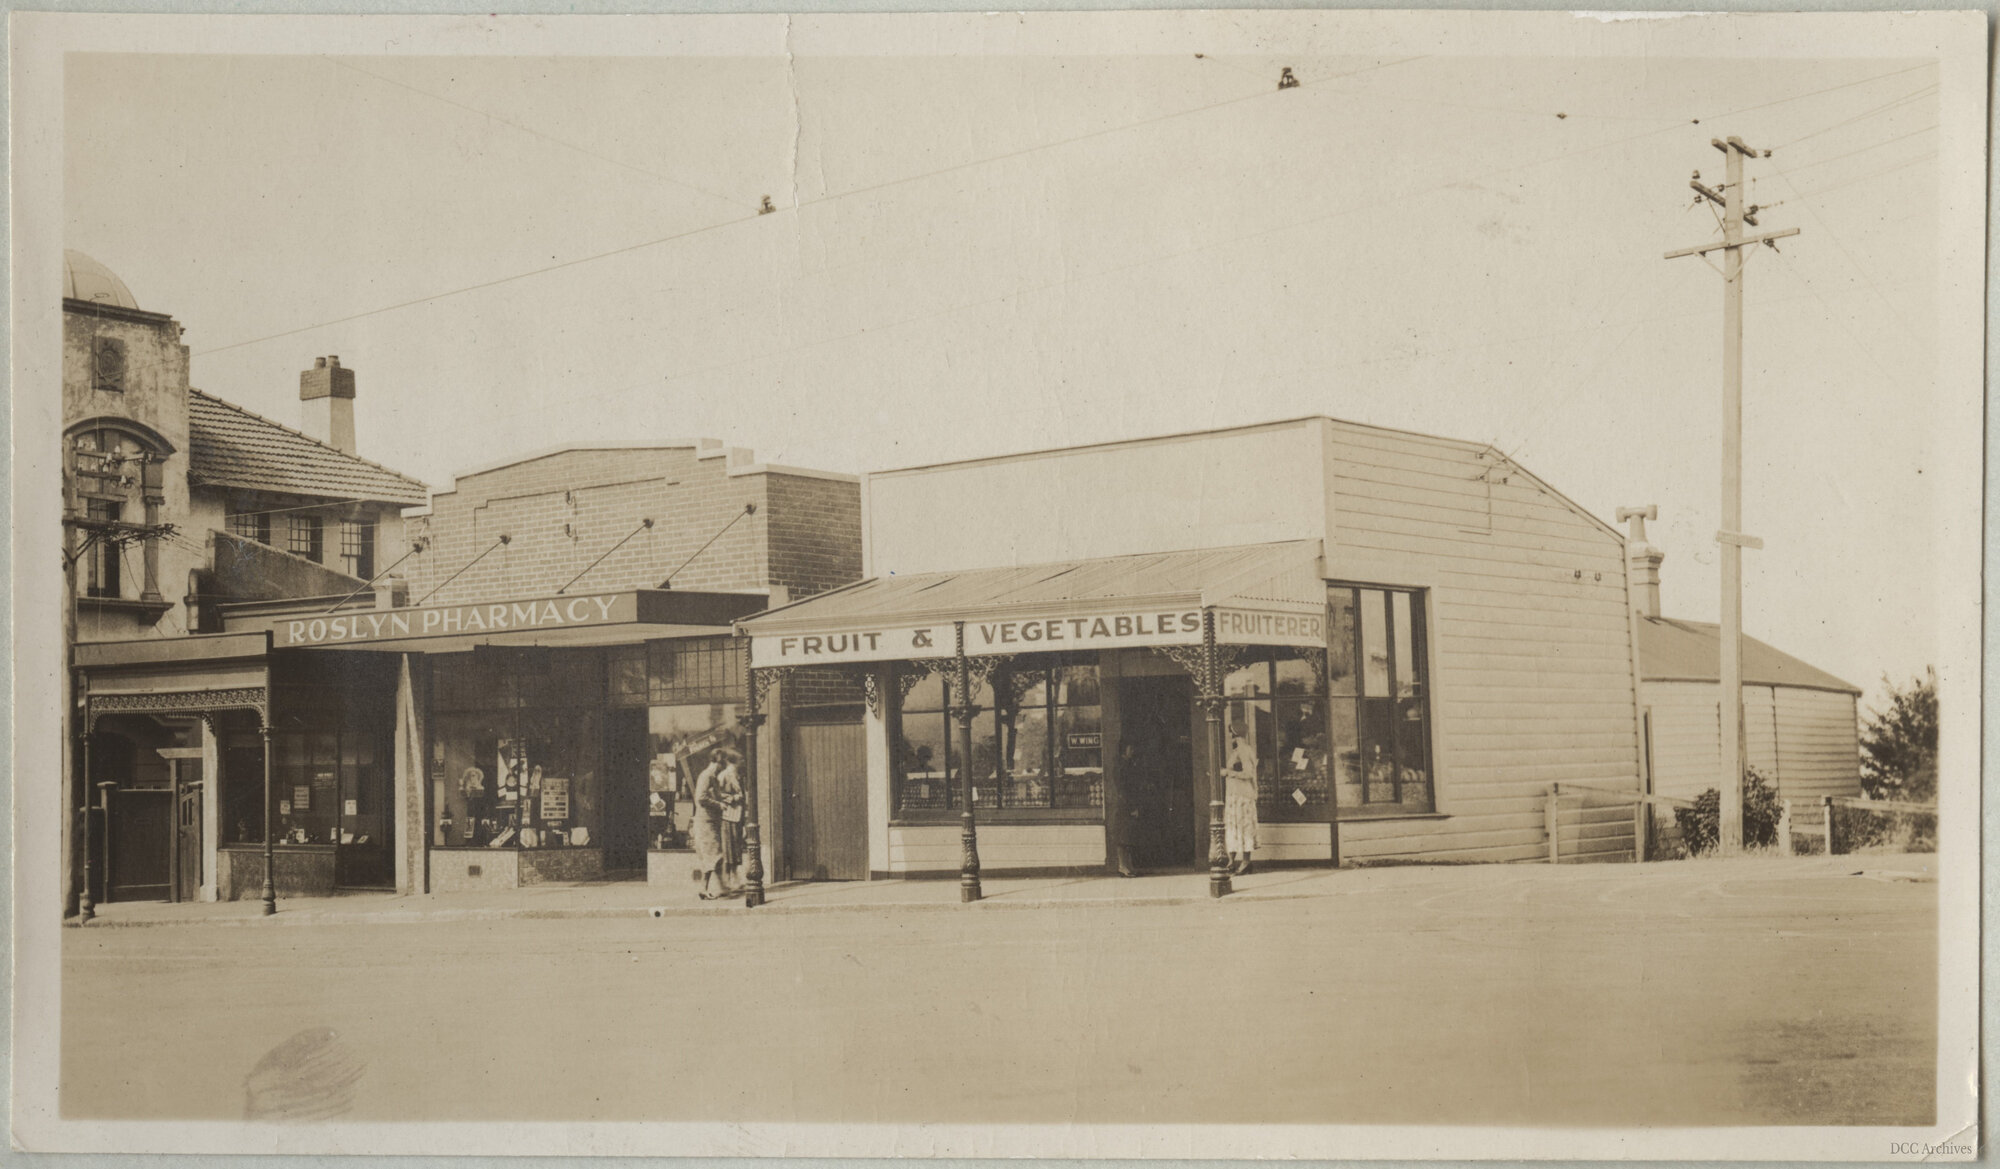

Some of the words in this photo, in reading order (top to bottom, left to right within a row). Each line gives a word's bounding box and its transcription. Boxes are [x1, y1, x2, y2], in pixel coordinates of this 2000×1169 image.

[289, 613, 410, 643] ROSLYN
[423, 596, 617, 633] PHARMACY
[781, 632, 882, 656] FRUIT
[912, 629, 933, 648] &
[980, 612, 1200, 644] VEGETABLES
[1220, 612, 1320, 638] FRUITERER
